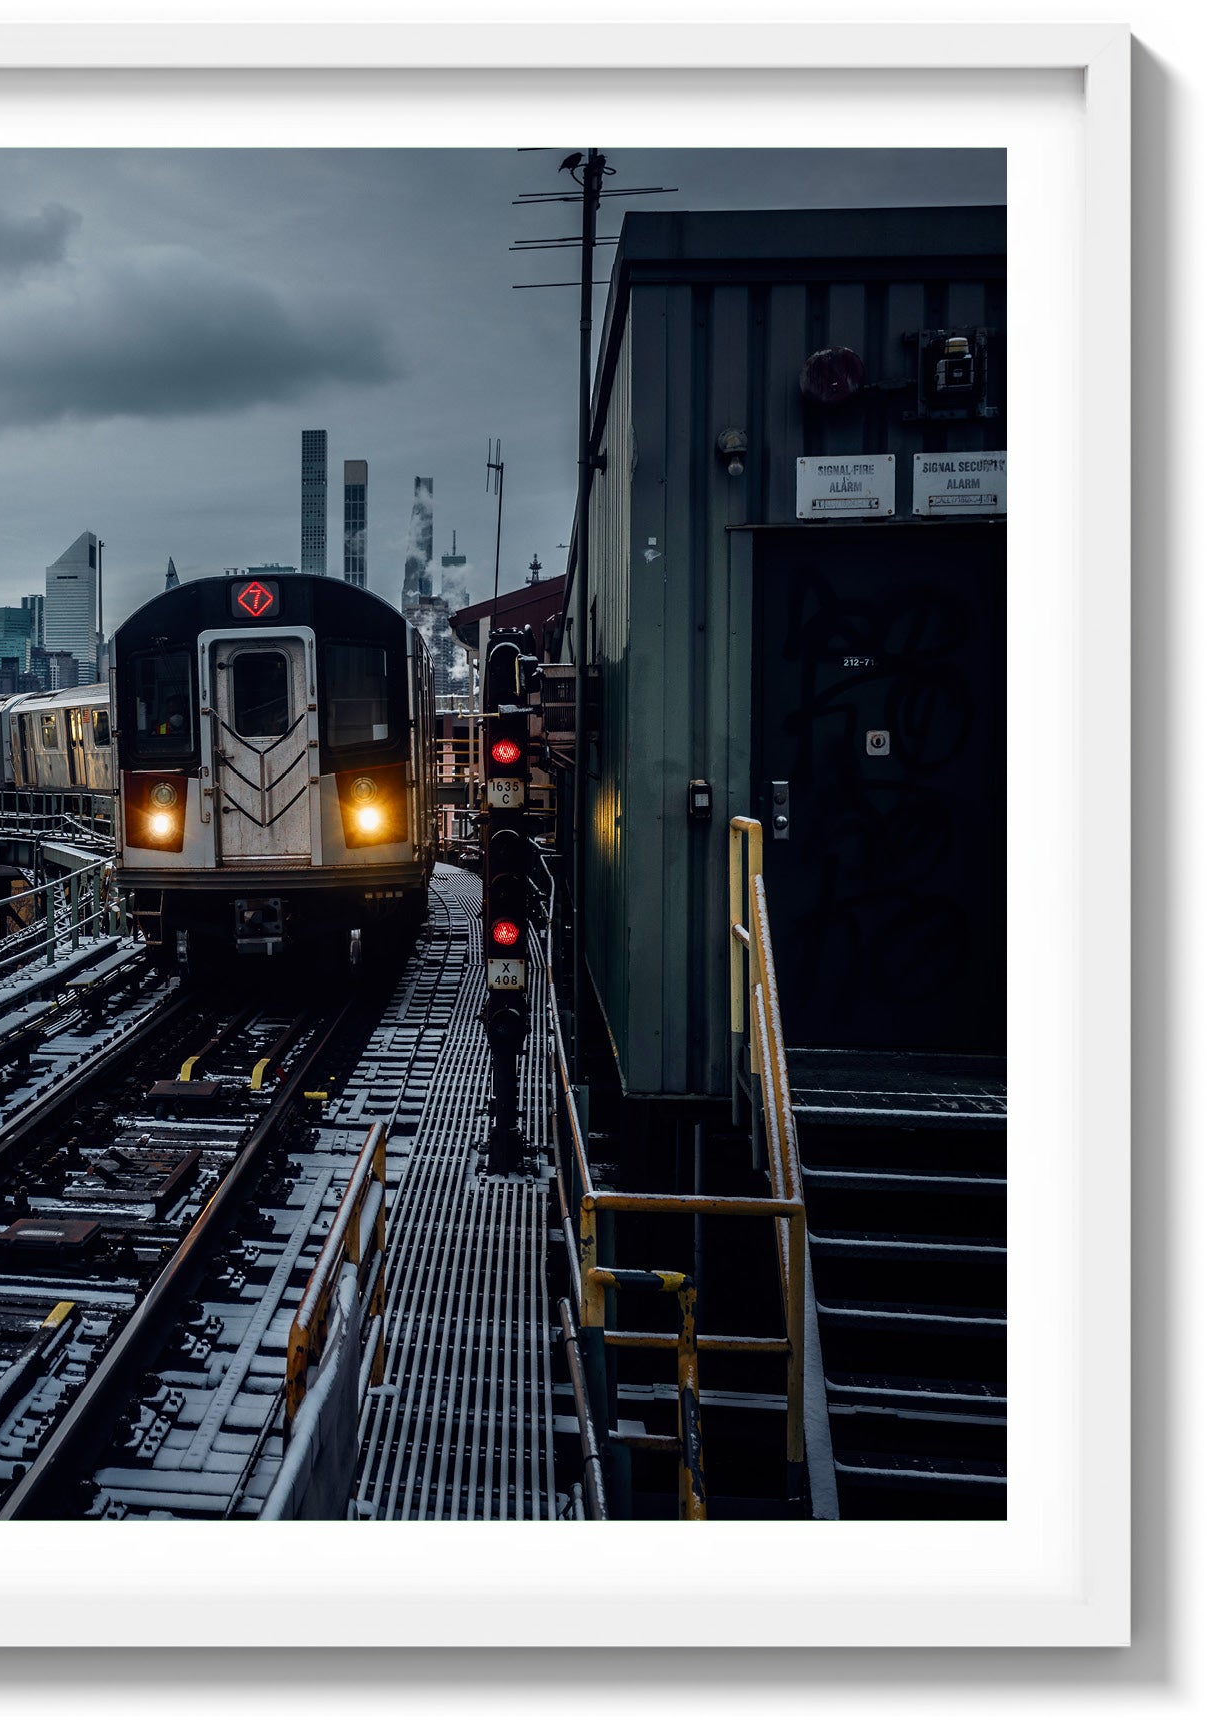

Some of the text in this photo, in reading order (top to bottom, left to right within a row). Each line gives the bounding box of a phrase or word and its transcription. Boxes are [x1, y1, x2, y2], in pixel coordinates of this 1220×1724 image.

[817, 463, 875, 477] SIGNAL FIRE
[922, 462, 956, 474] SIGNAL
[829, 481, 863, 493] ALARM
[945, 478, 980, 490] ALARM
[249, 589, 261, 611] 7
[843, 658, 879, 667] 212-71
[492, 781, 519, 791] 1635
[502, 793, 510, 804] C
[502, 962, 510, 973] X
[494, 975, 518, 986] 408
